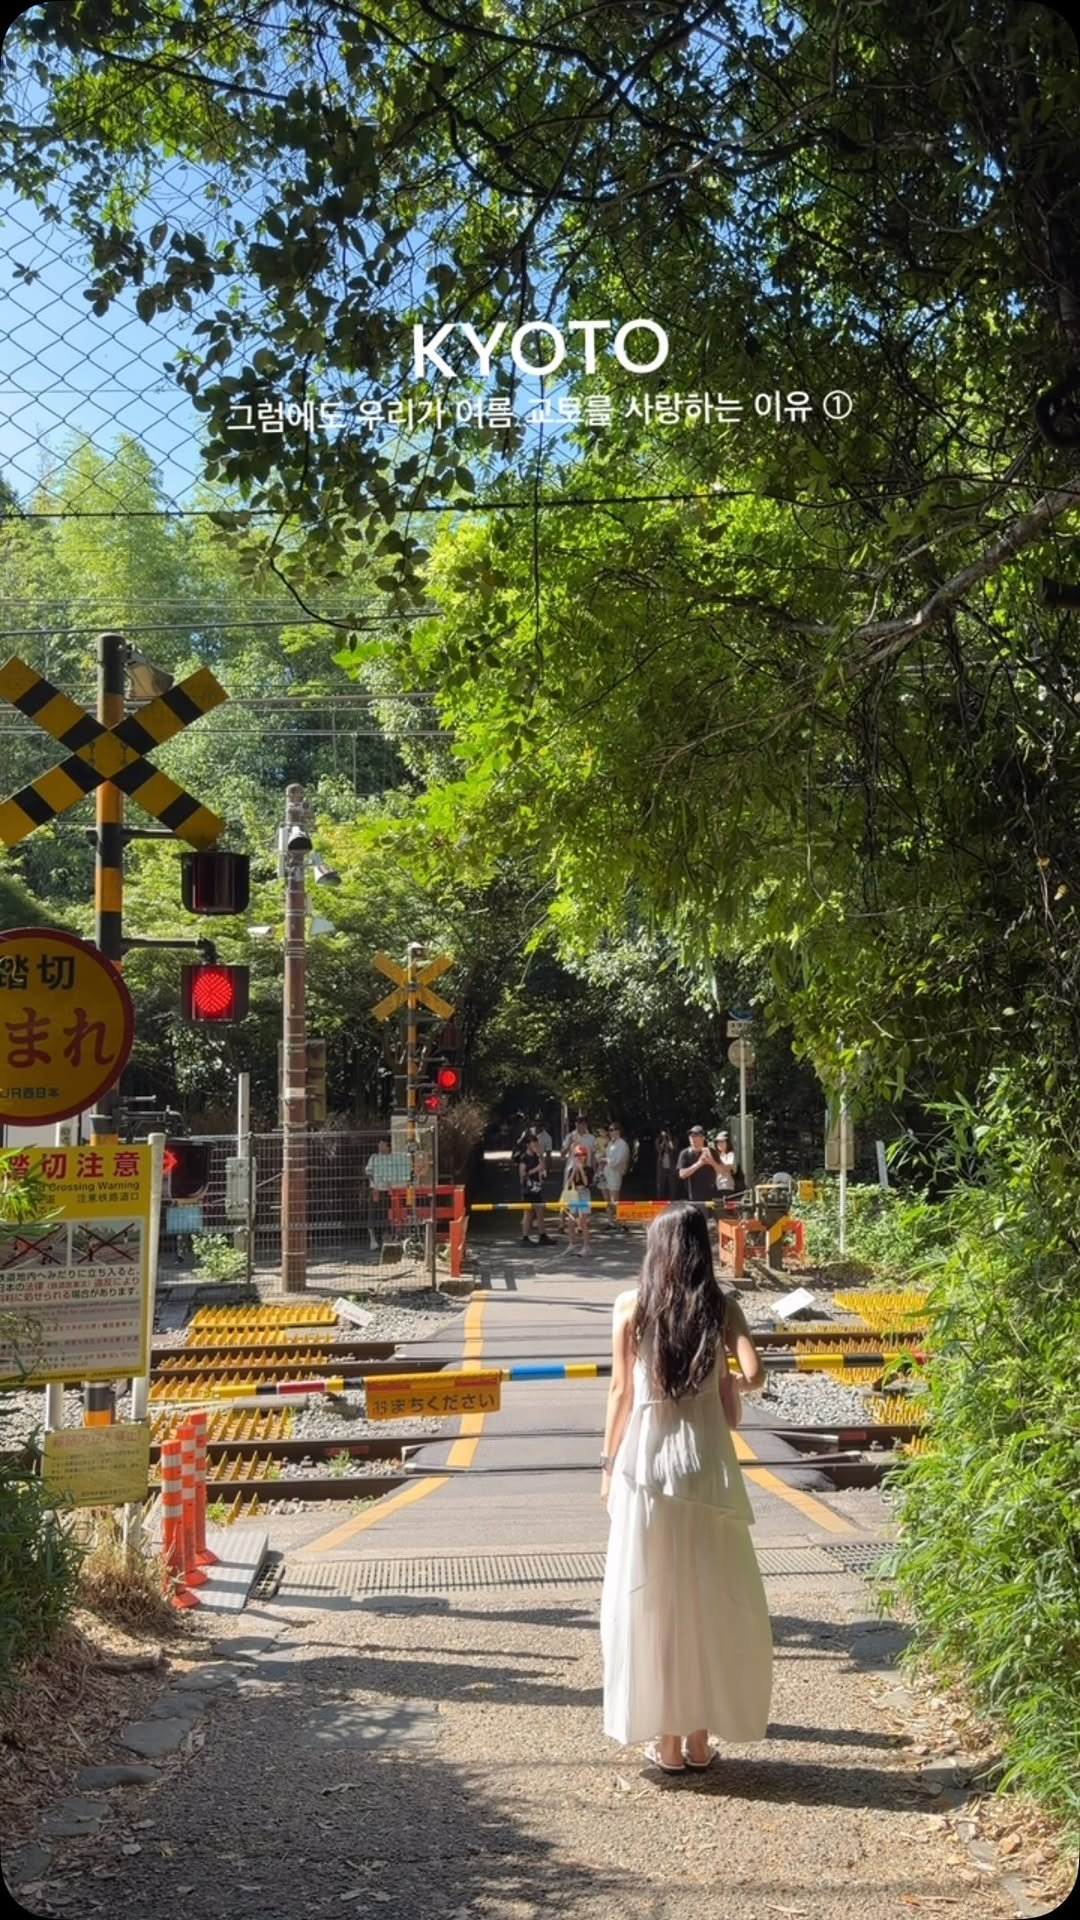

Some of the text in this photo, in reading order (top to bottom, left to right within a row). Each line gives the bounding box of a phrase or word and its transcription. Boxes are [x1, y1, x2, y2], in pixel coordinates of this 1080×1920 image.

[0, 954, 76, 990] 踏切
[4, 1152, 140, 1181] 踏切注意
[98, 1181, 140, 1190] Warning
[373, 1393, 496, 1415] おまちください
